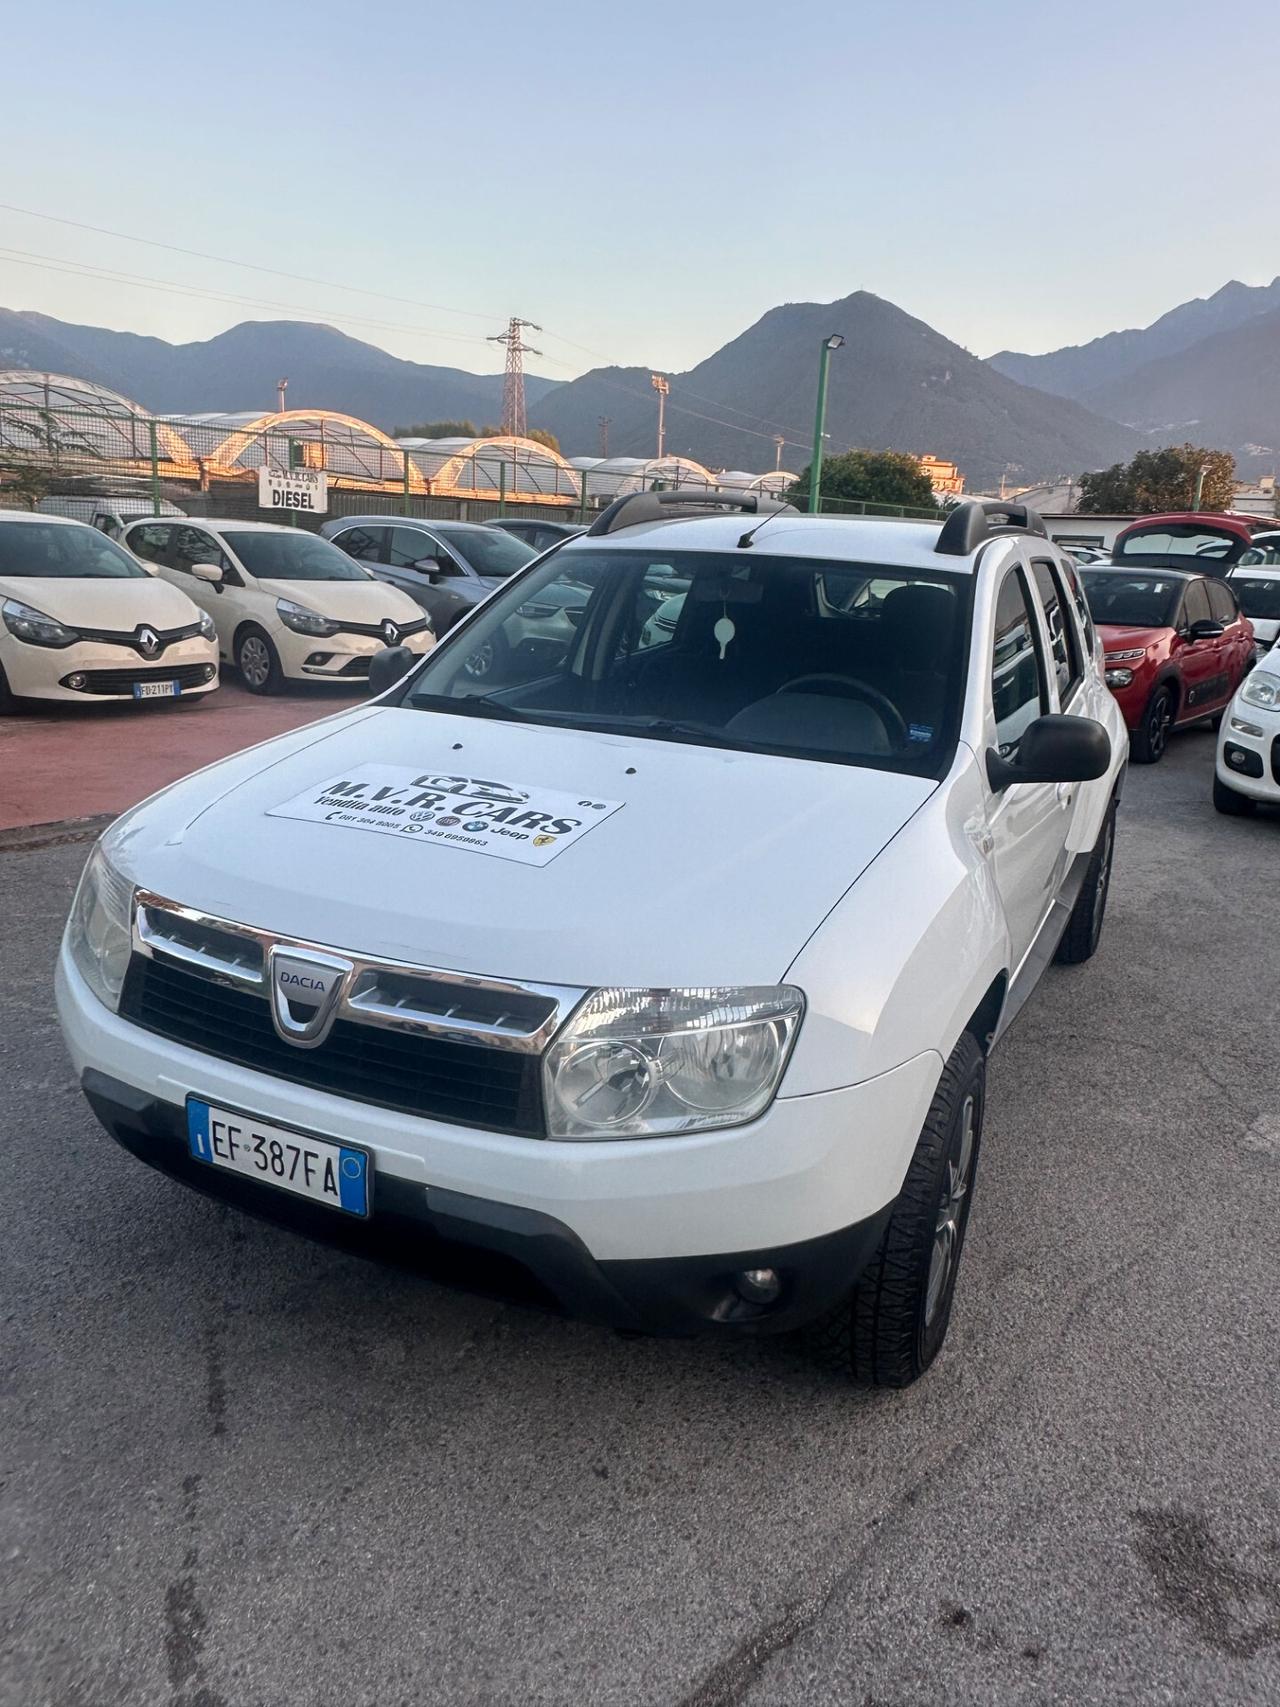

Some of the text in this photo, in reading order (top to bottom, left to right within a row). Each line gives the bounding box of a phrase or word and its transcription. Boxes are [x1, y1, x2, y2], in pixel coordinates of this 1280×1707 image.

[272, 489, 315, 509] DIESEL
[313, 796, 406, 816] Vendita auto
[320, 781, 582, 834] M.V.R. CARS
[490, 827, 530, 841] Jeep
[280, 971, 326, 992] DACIA
